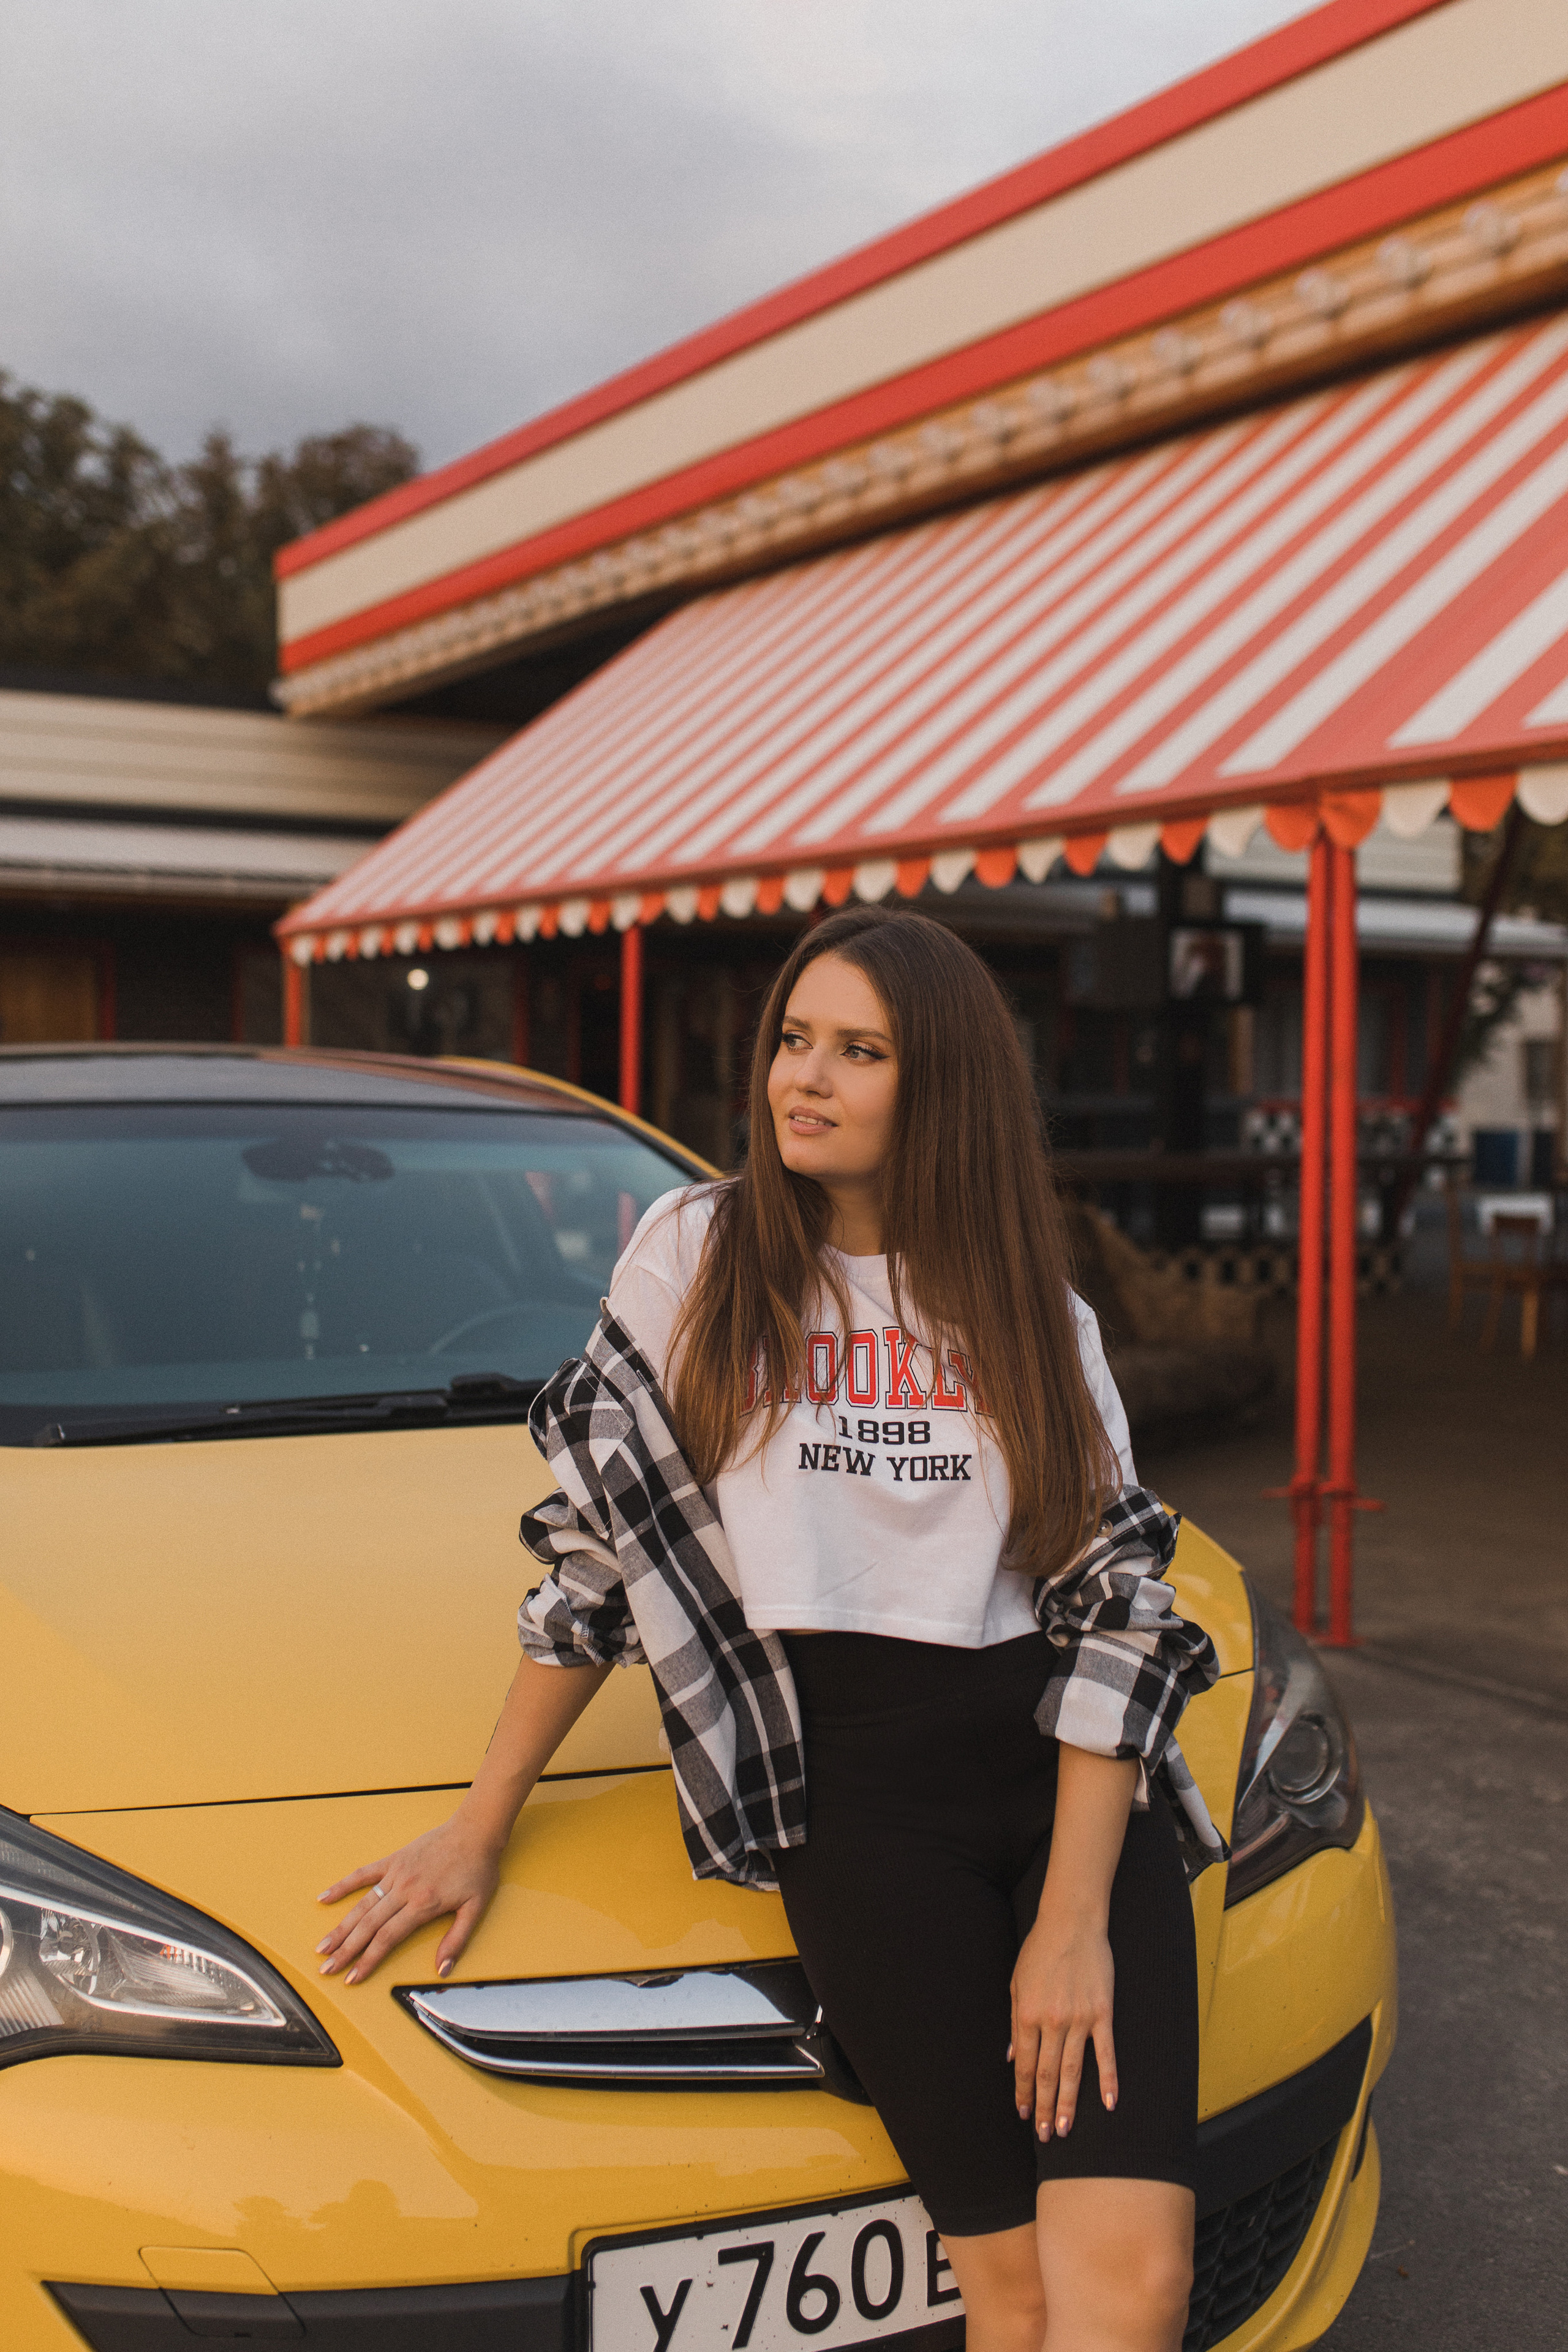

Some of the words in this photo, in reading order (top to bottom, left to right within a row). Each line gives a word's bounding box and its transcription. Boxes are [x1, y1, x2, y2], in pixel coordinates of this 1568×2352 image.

[739, 1326, 996, 1419] OOKL
[838, 1415, 930, 1446] 1898
[798, 1442, 876, 1476] NEW
[886, 1454, 973, 1482] YORK
